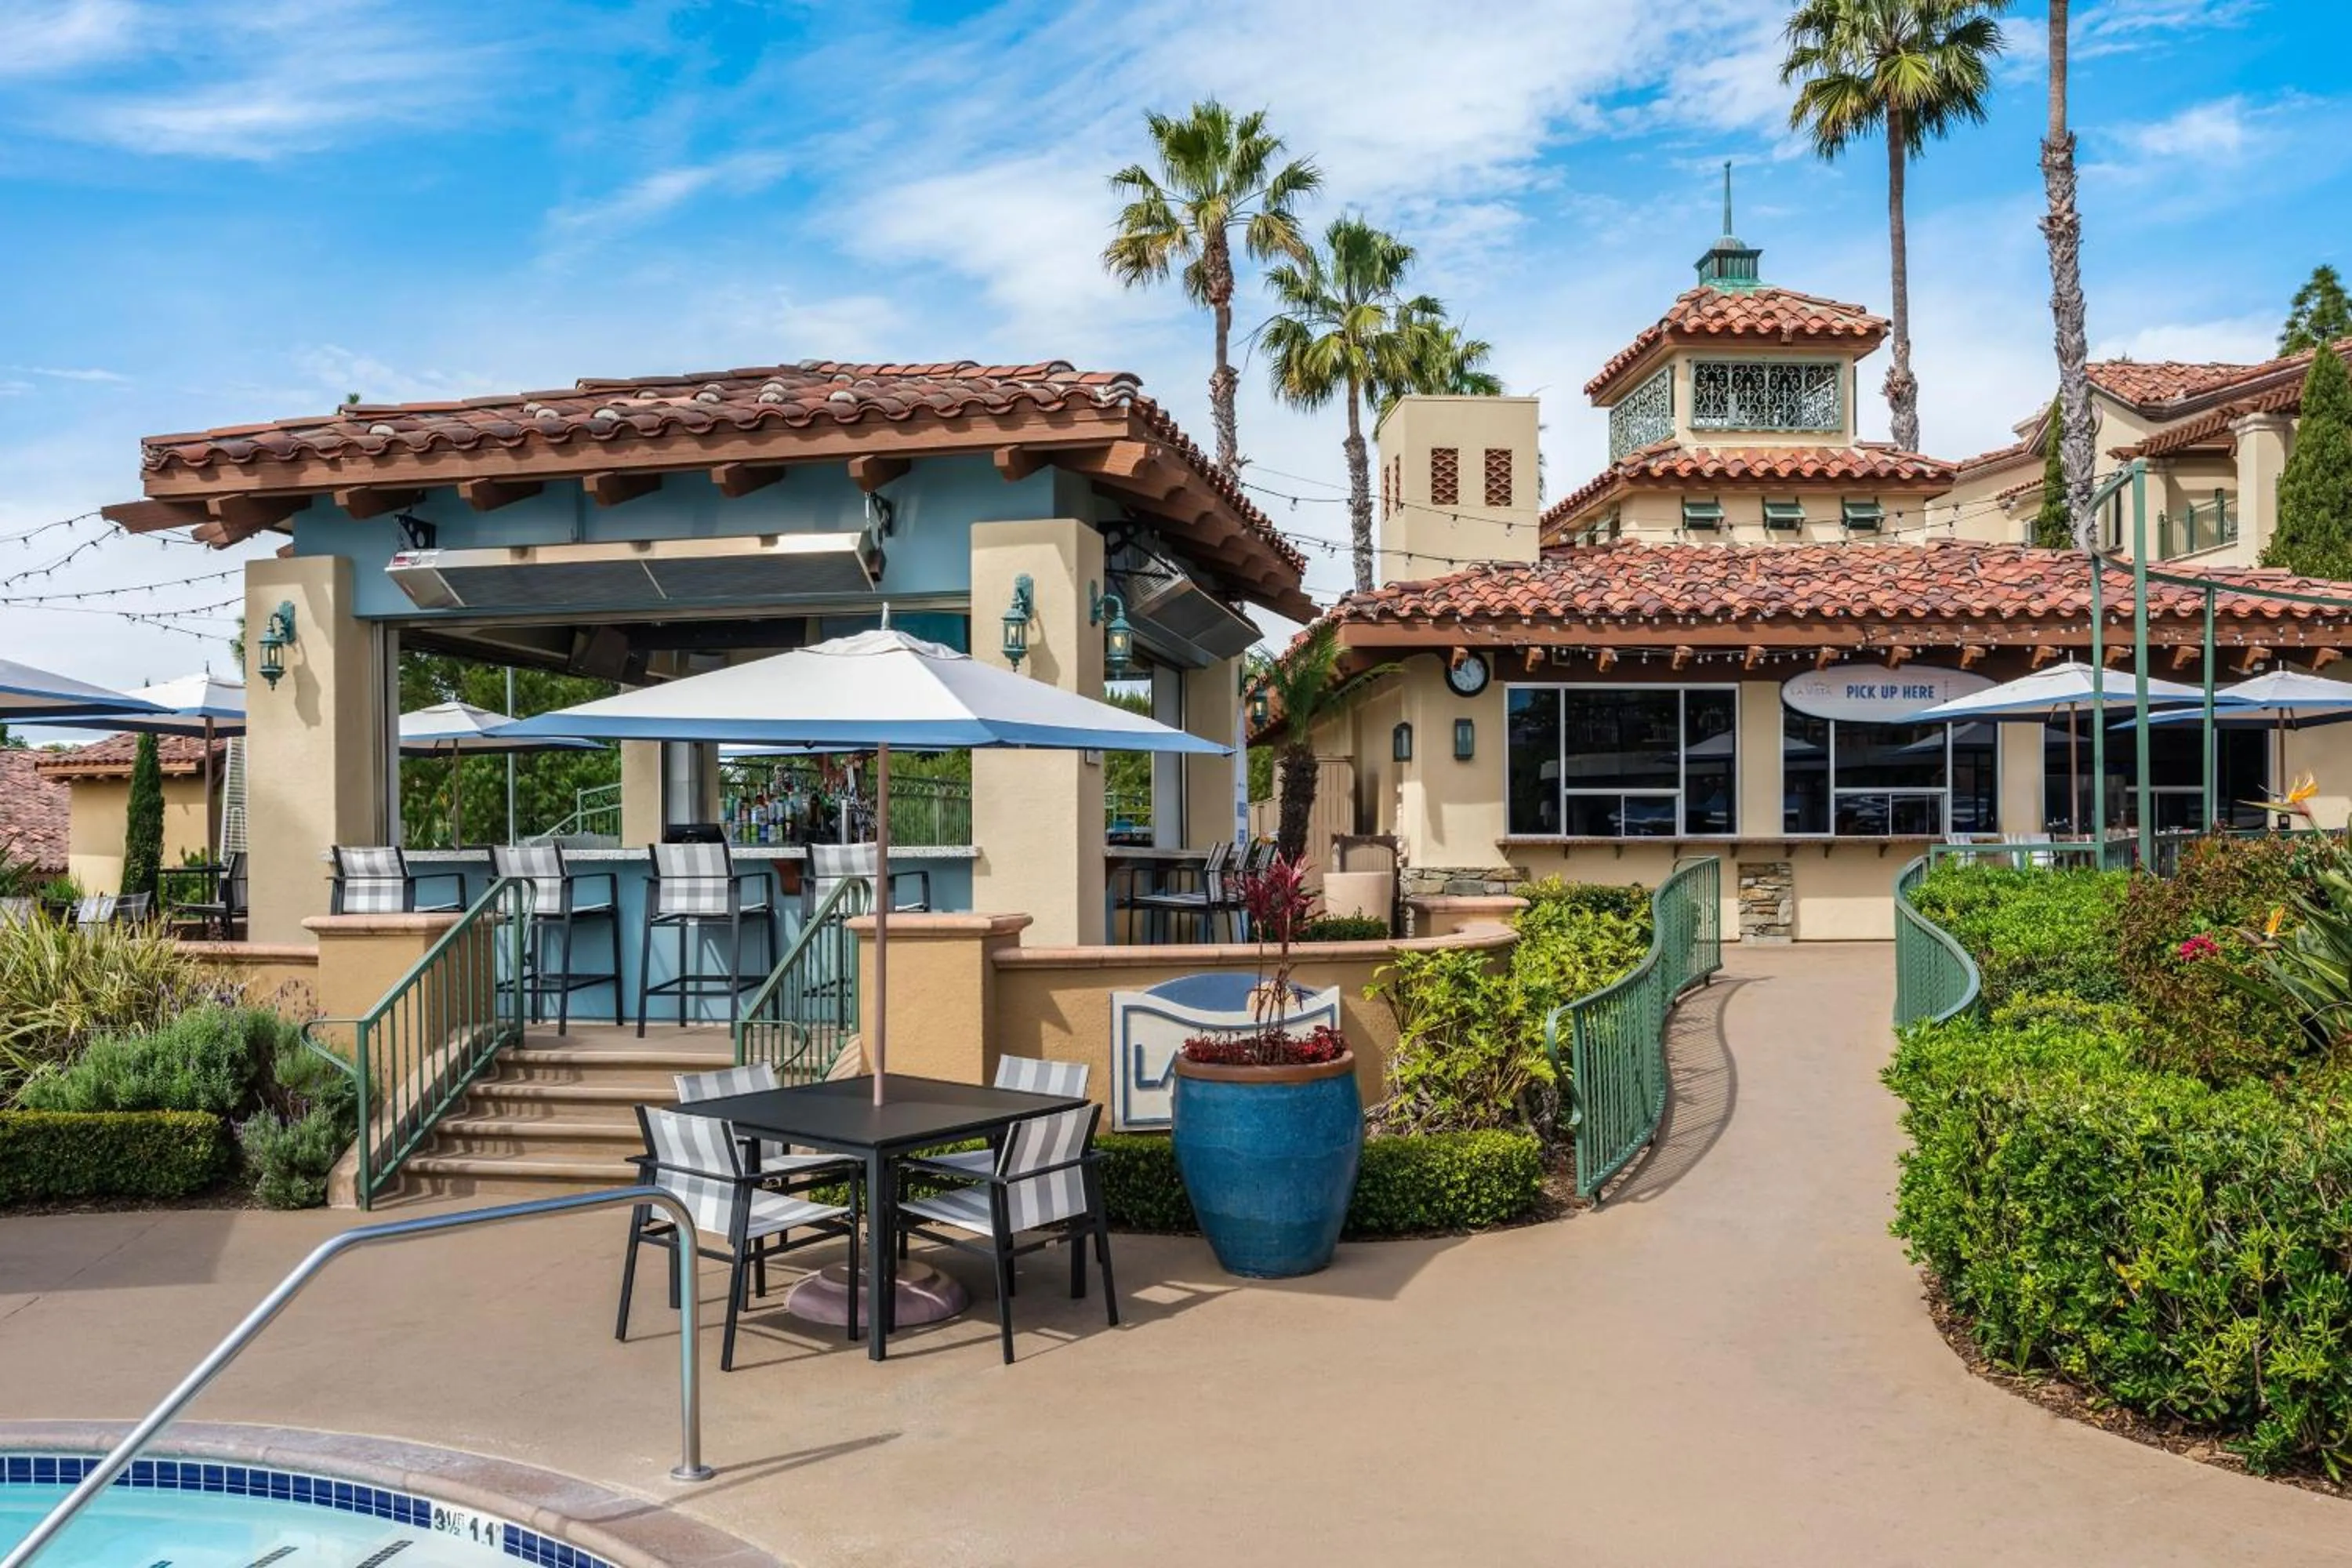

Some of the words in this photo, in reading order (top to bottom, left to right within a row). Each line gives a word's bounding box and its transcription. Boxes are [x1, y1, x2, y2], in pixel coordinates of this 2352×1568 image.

[1846, 684, 1876, 699] PICK
[1881, 684, 1898, 699] UP
[1903, 684, 1935, 699] HERE
[469, 1517, 495, 1547] 1.1
